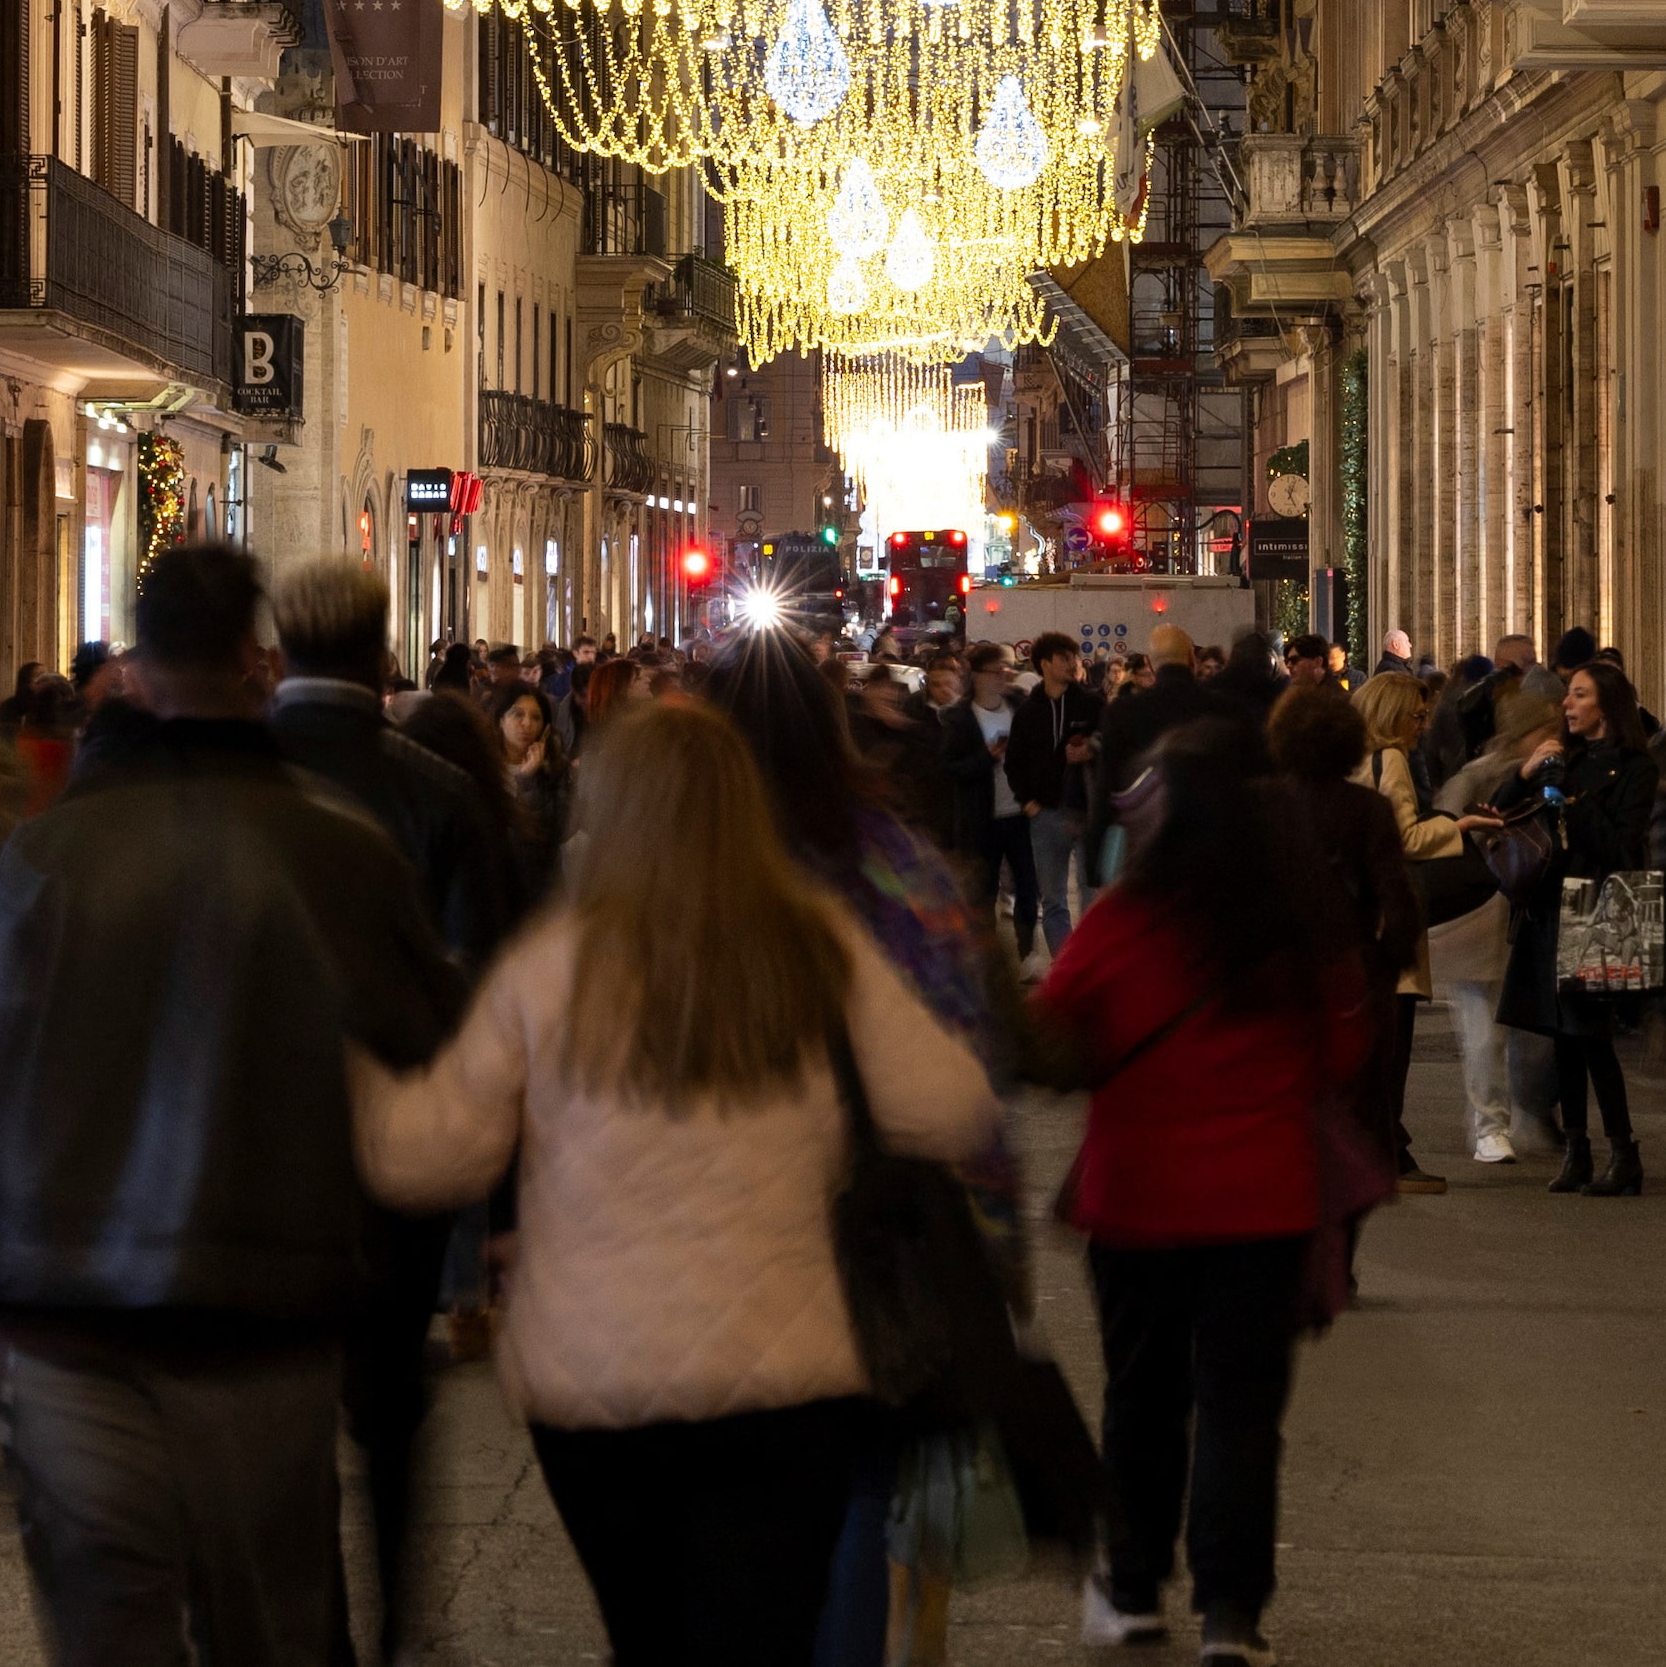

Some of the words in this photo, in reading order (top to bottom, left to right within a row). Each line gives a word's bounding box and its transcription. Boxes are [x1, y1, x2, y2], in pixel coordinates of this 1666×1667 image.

[346, 56, 374, 66] ISON
[351, 70, 404, 80] LLECTION
[244, 331, 275, 384] B
[237, 387, 283, 396] COCKTAIL
[250, 396, 269, 404] BAR
[785, 545, 830, 553] POLIZIA
[1258, 543, 1308, 551] intimissi
